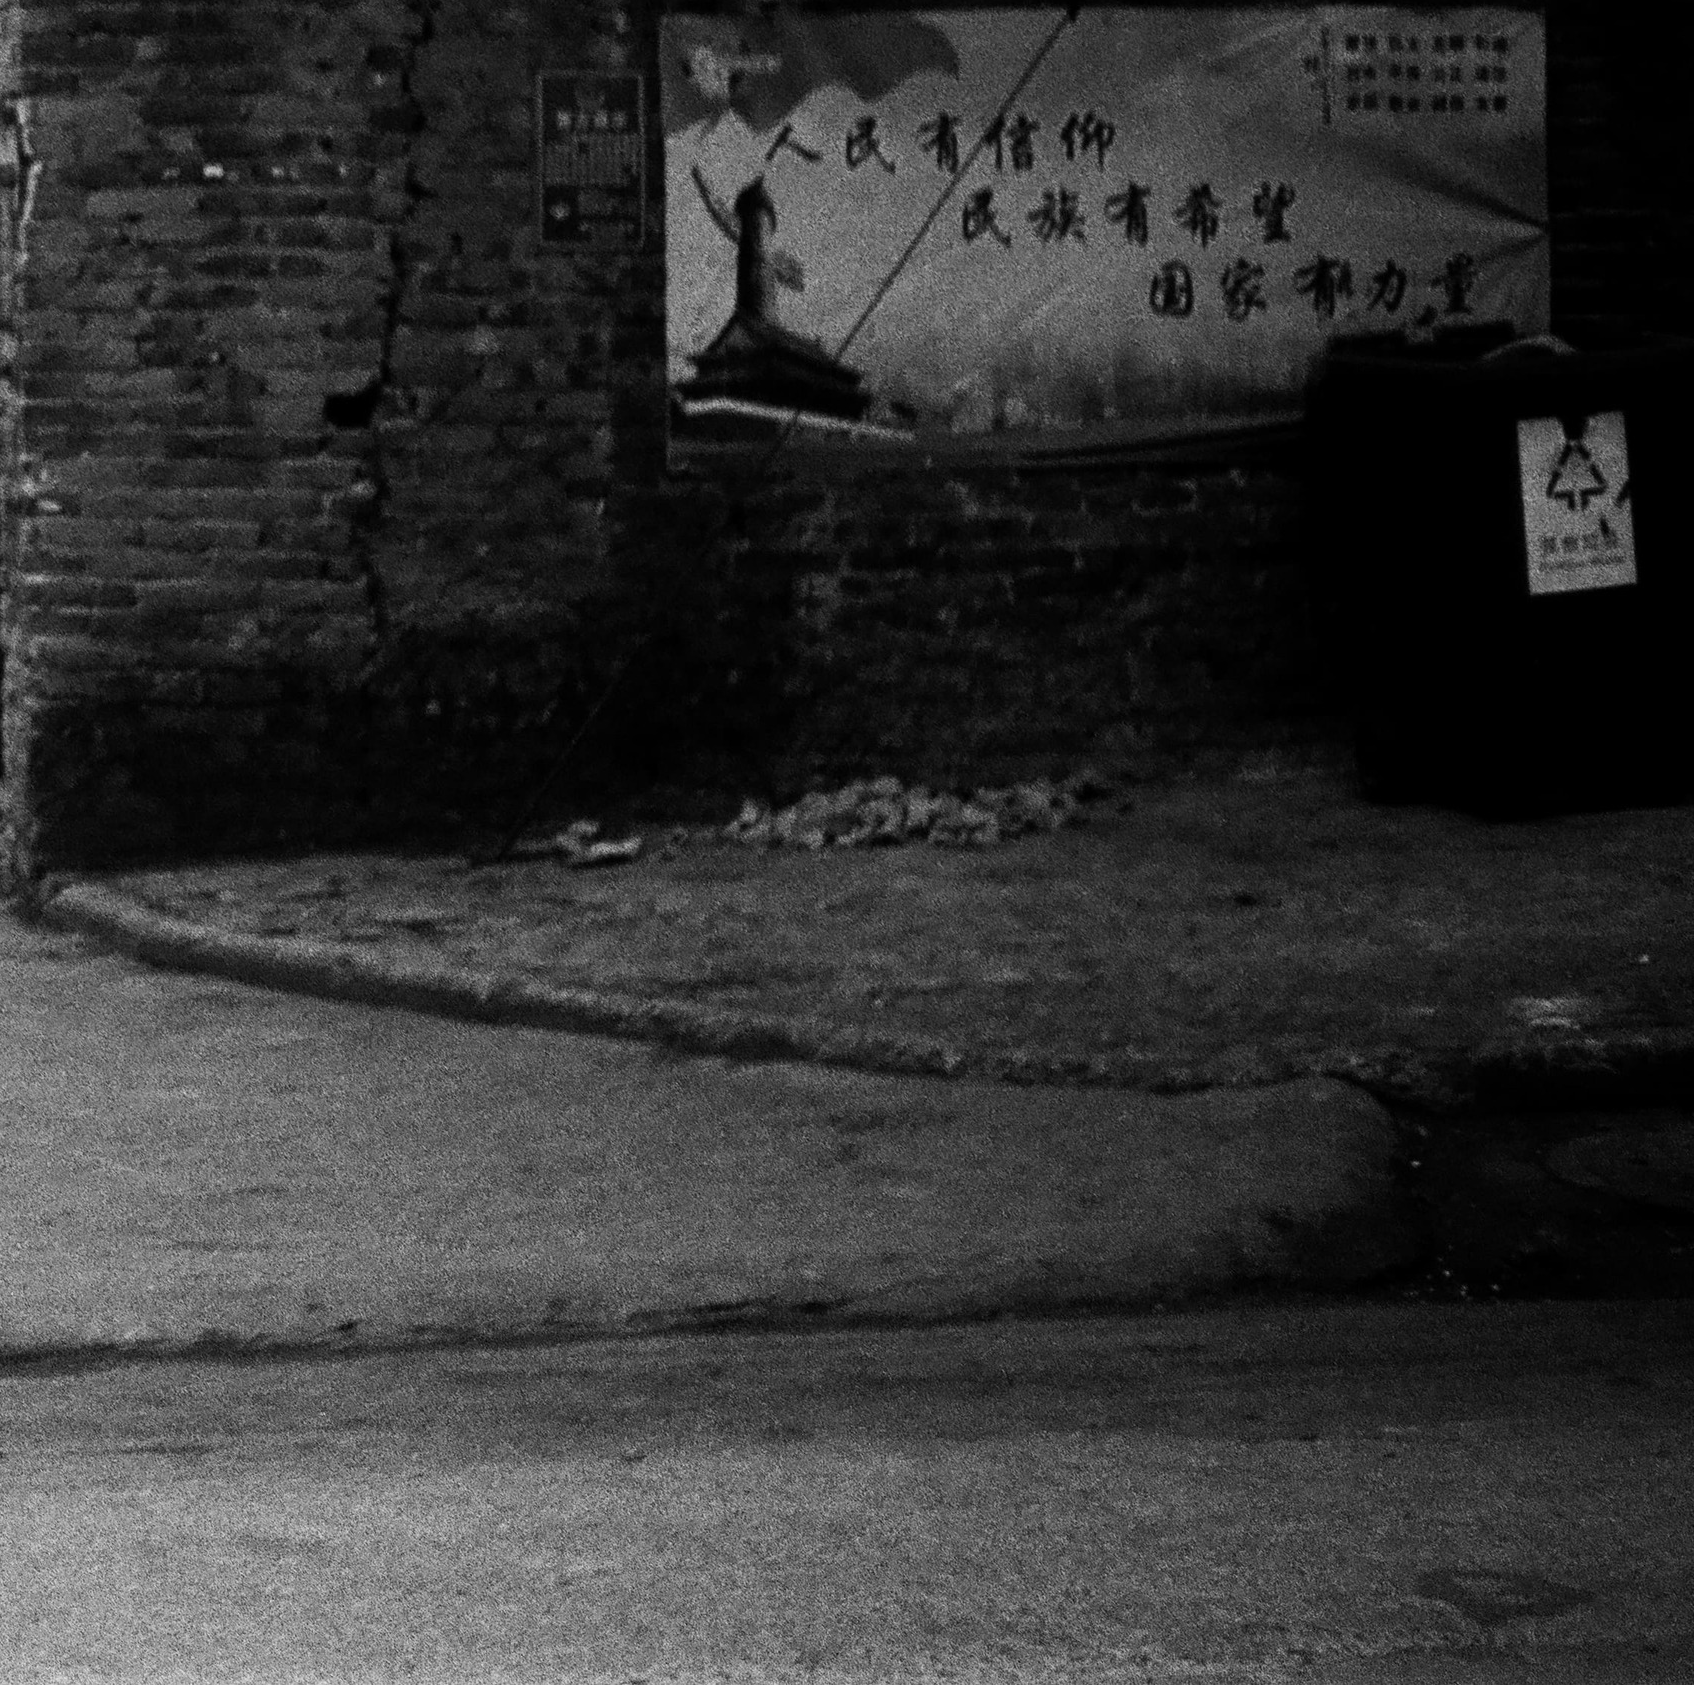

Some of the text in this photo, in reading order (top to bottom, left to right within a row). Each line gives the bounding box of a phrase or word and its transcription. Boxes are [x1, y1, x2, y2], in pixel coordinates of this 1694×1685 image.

[765, 110, 1116, 176] 人民有信仰
[962, 180, 1297, 248] 民族有希望
[1148, 252, 1479, 321] 国家有力量
